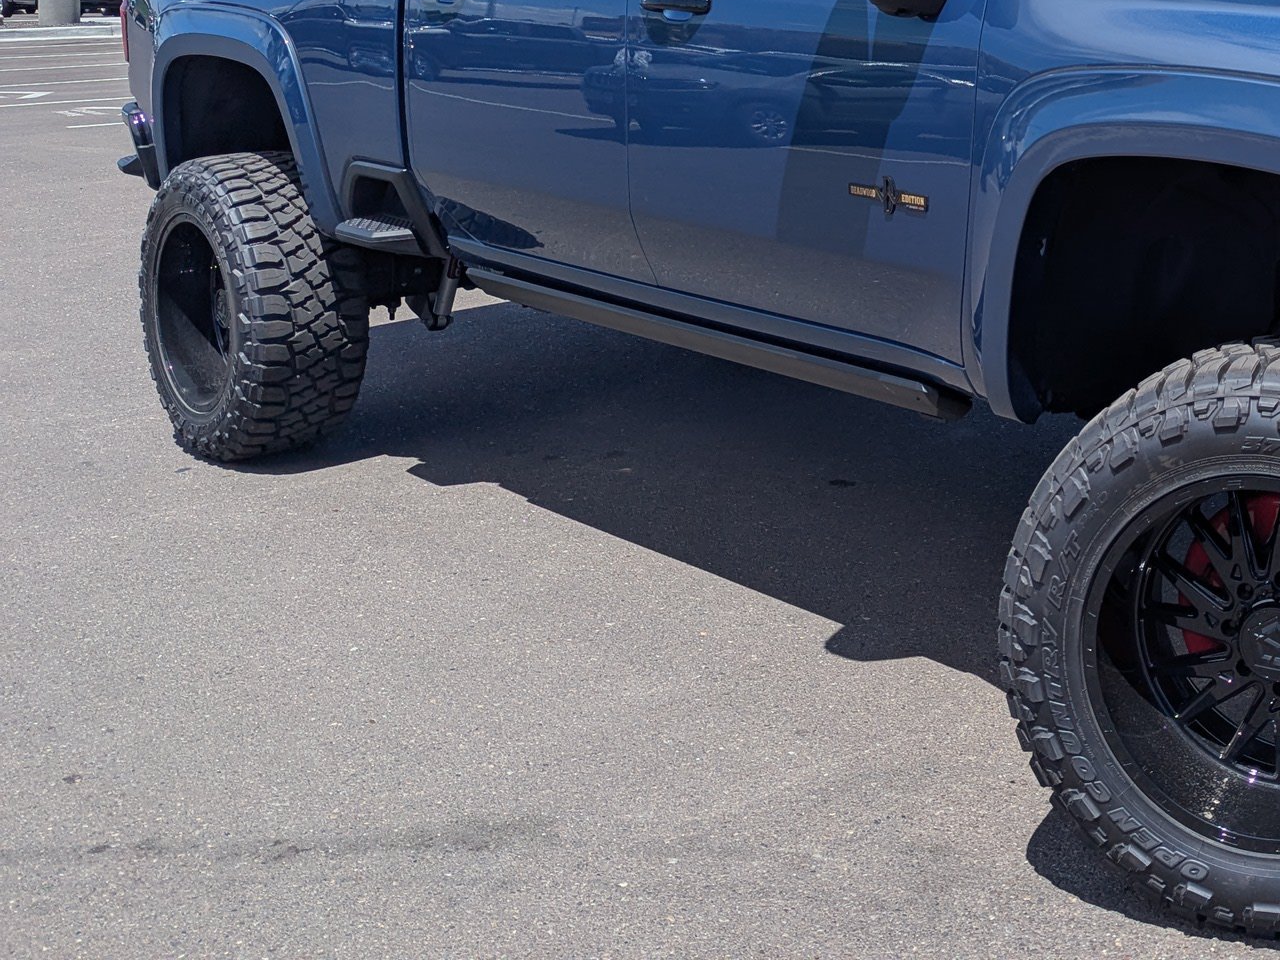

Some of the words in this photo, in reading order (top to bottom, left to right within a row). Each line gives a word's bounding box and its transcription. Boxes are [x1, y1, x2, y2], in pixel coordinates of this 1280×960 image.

[901, 193, 925, 206] EDITION
[1047, 529, 1081, 609] R/T
[1041, 617, 1112, 803] COUNTRY
[1107, 806, 1210, 881] OPEN
